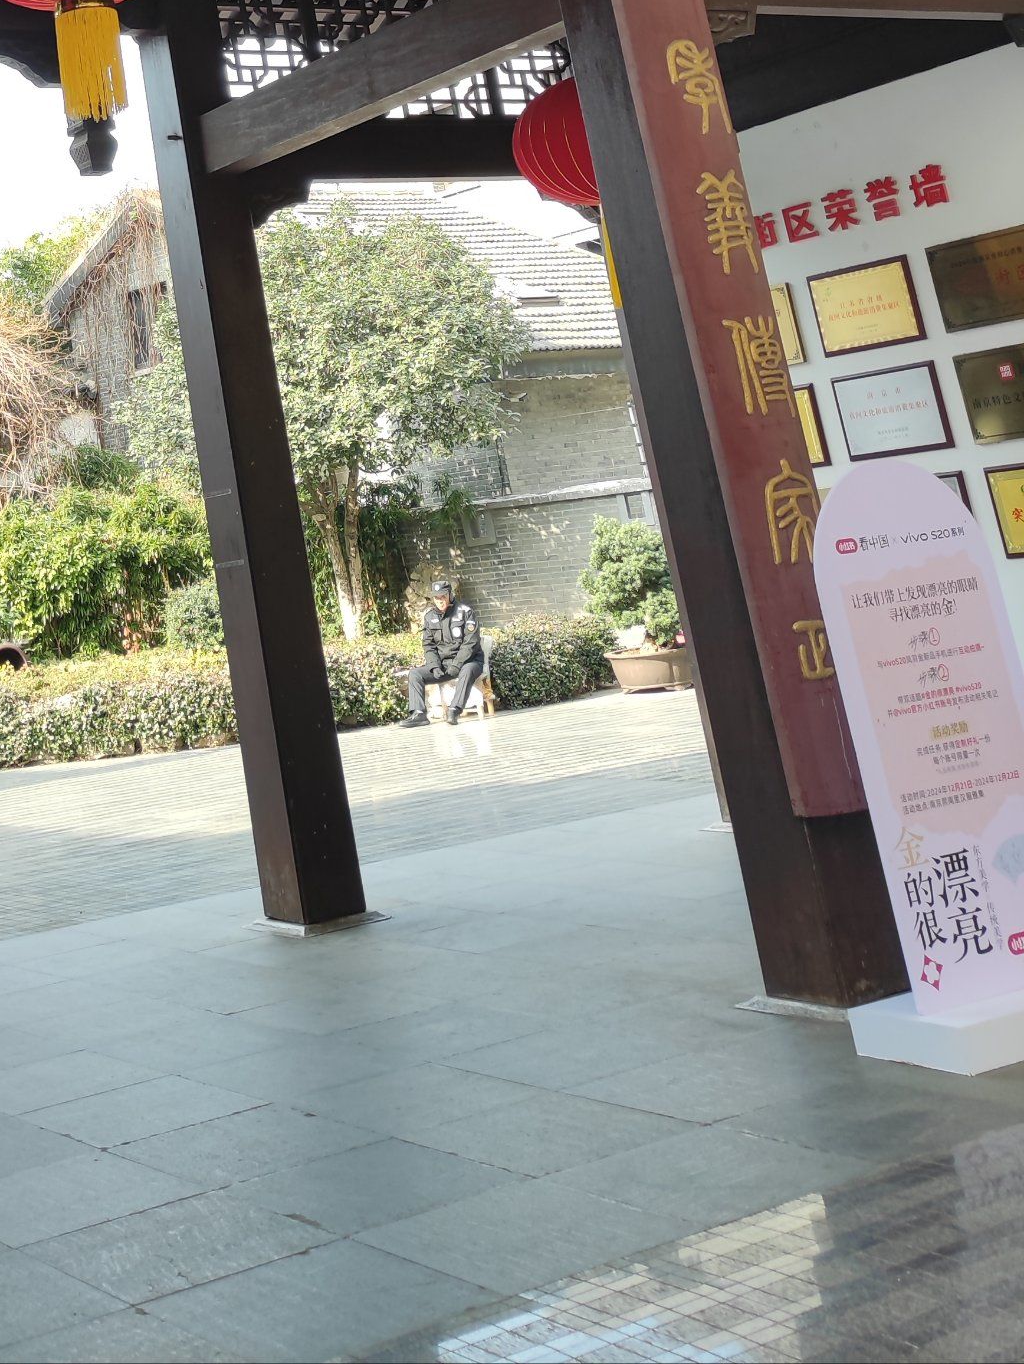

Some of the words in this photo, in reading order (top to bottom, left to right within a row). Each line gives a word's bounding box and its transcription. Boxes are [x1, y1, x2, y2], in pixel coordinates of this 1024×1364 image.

[754, 164, 950, 248] 街区荣誉墙
[972, 391, 1024, 410] 南京特色文
[859, 534, 890, 551] 看中国
[900, 533, 929, 544] vivo
[931, 526, 965, 540] S20系列
[850, 576, 979, 609] 让我们带上发现漂亮的眼睛
